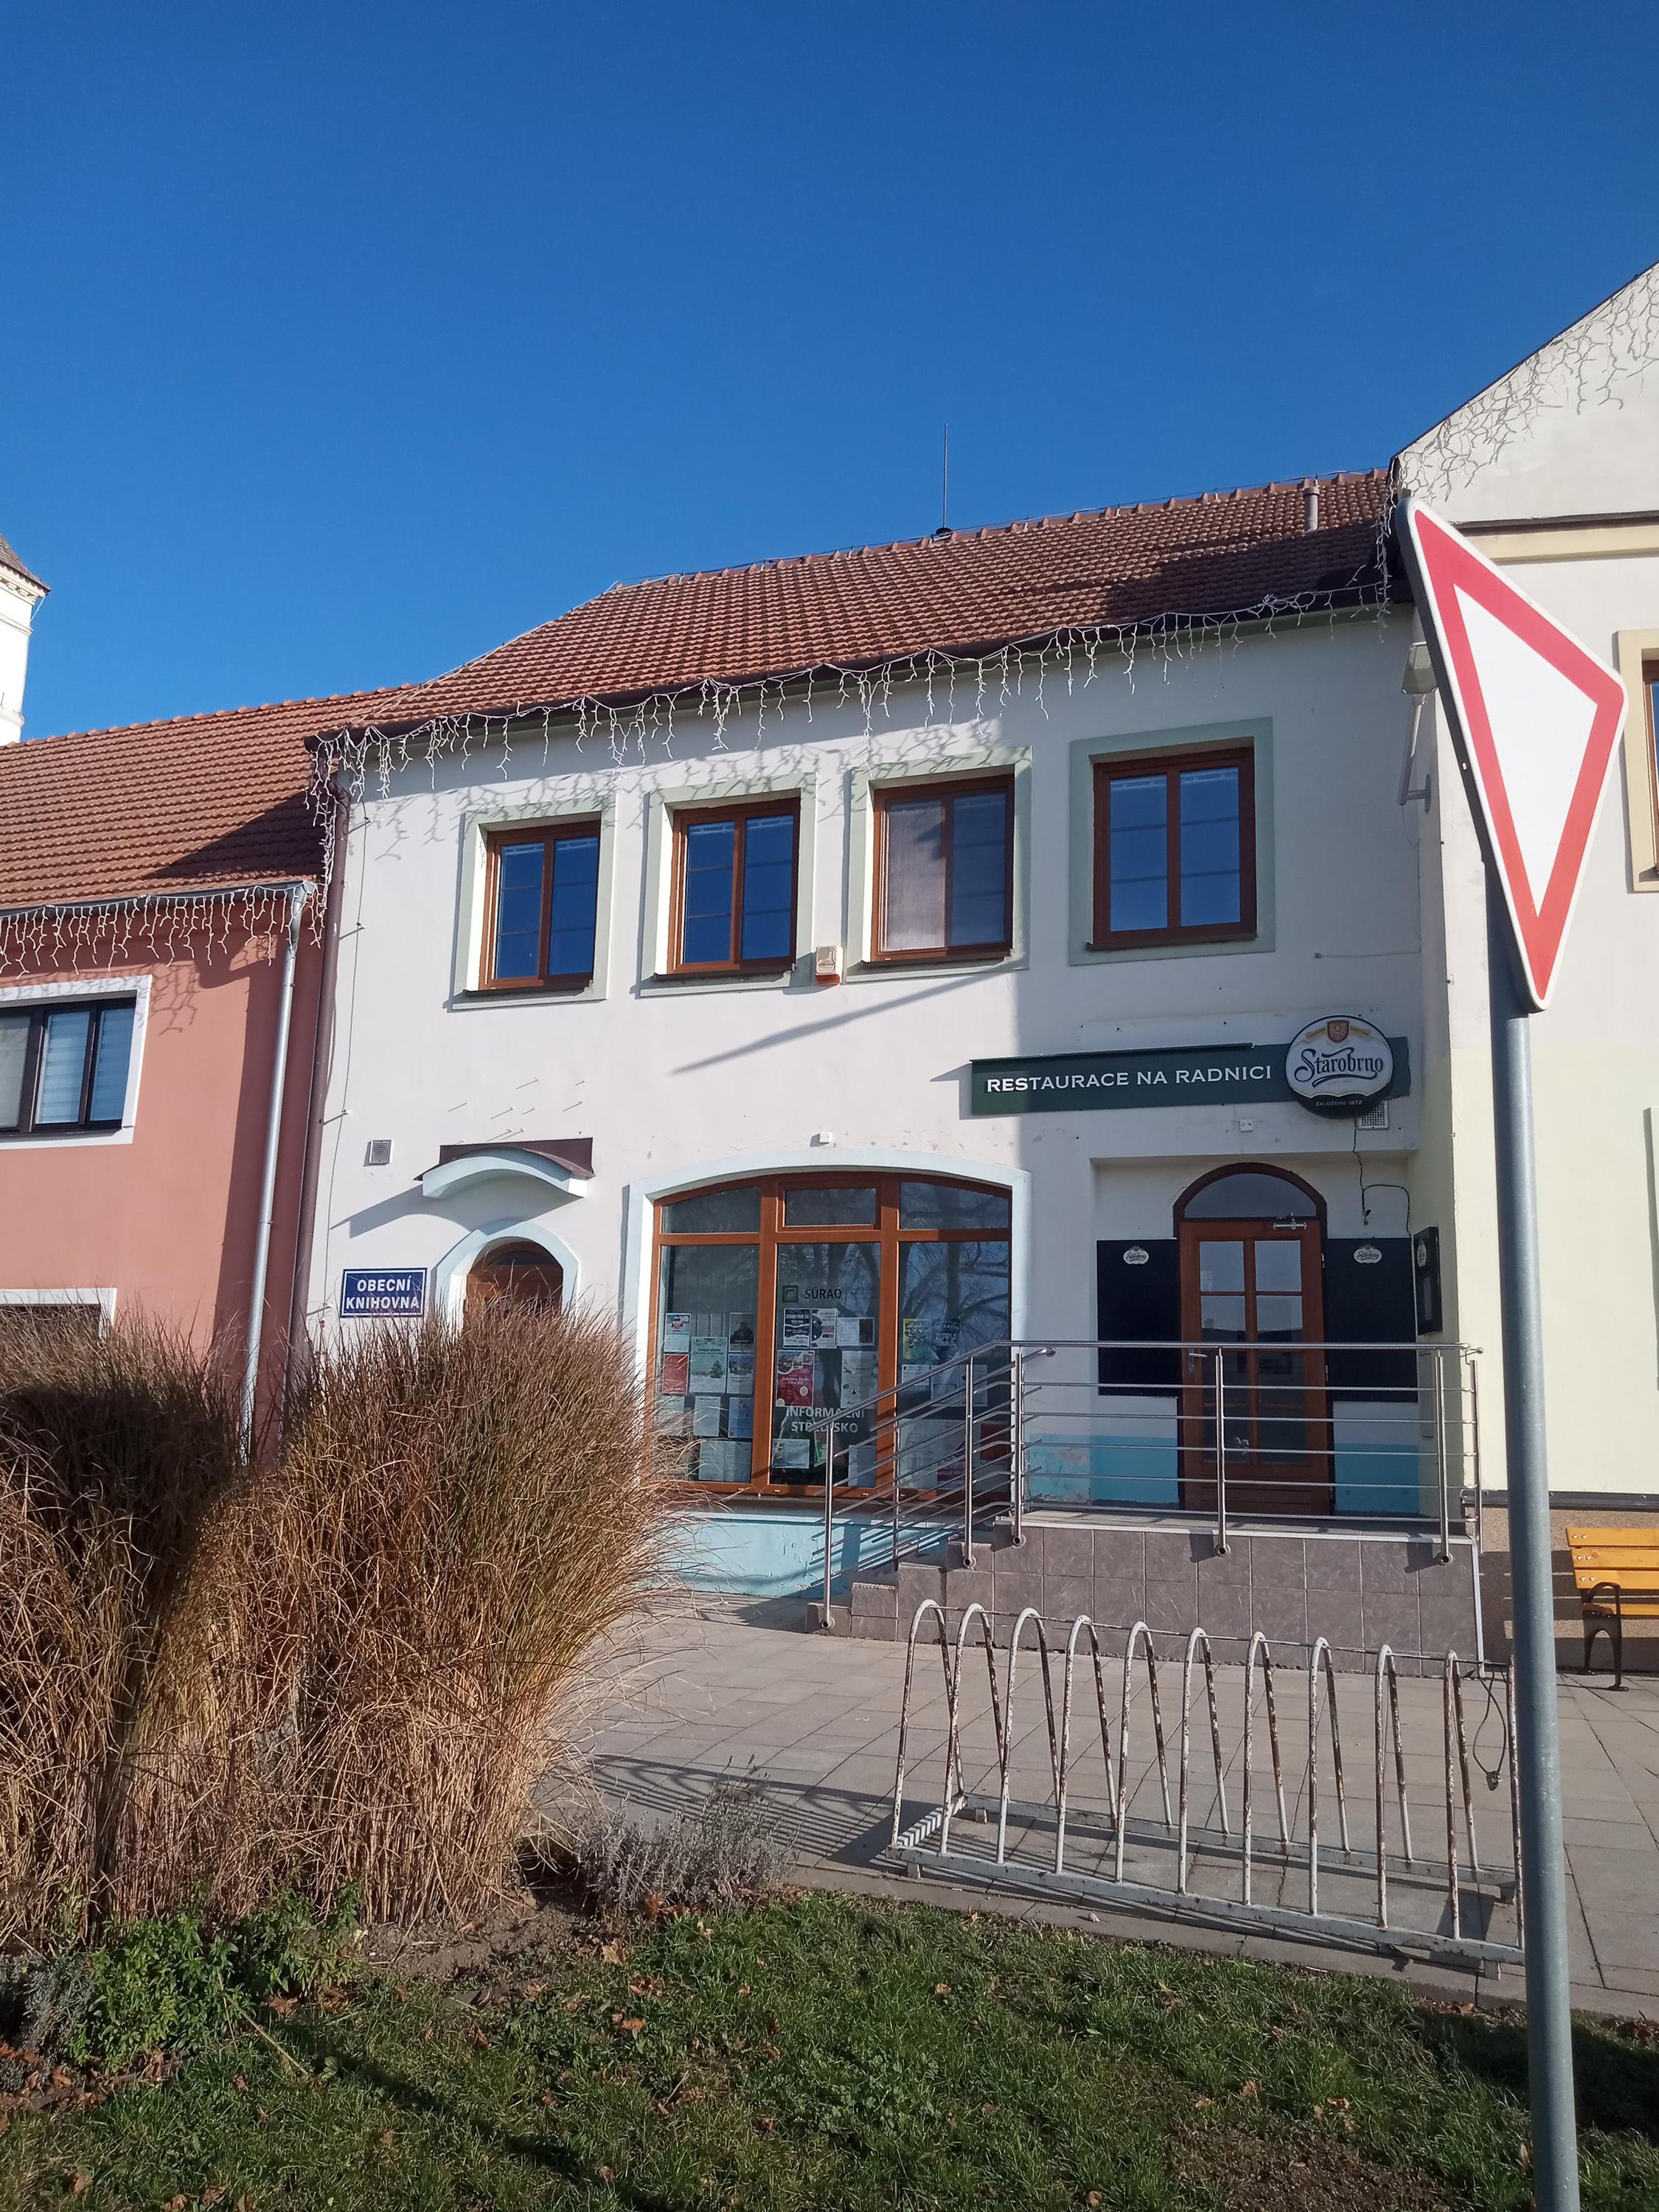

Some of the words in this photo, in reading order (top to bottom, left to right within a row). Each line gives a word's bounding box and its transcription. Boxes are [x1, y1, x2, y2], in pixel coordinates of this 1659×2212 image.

[1294, 1047, 1384, 1085] Starobrno
[987, 1072, 1130, 1093] RESTAURACE
[1137, 1071, 1168, 1085] NA
[1175, 1065, 1272, 1084] RADNICI
[357, 1275, 412, 1292] OBECNÍ
[804, 1286, 843, 1300] SÚRAO
[346, 1295, 420, 1310] KNIHOVNA
[786, 1407, 865, 1419] INFORMANÍ
